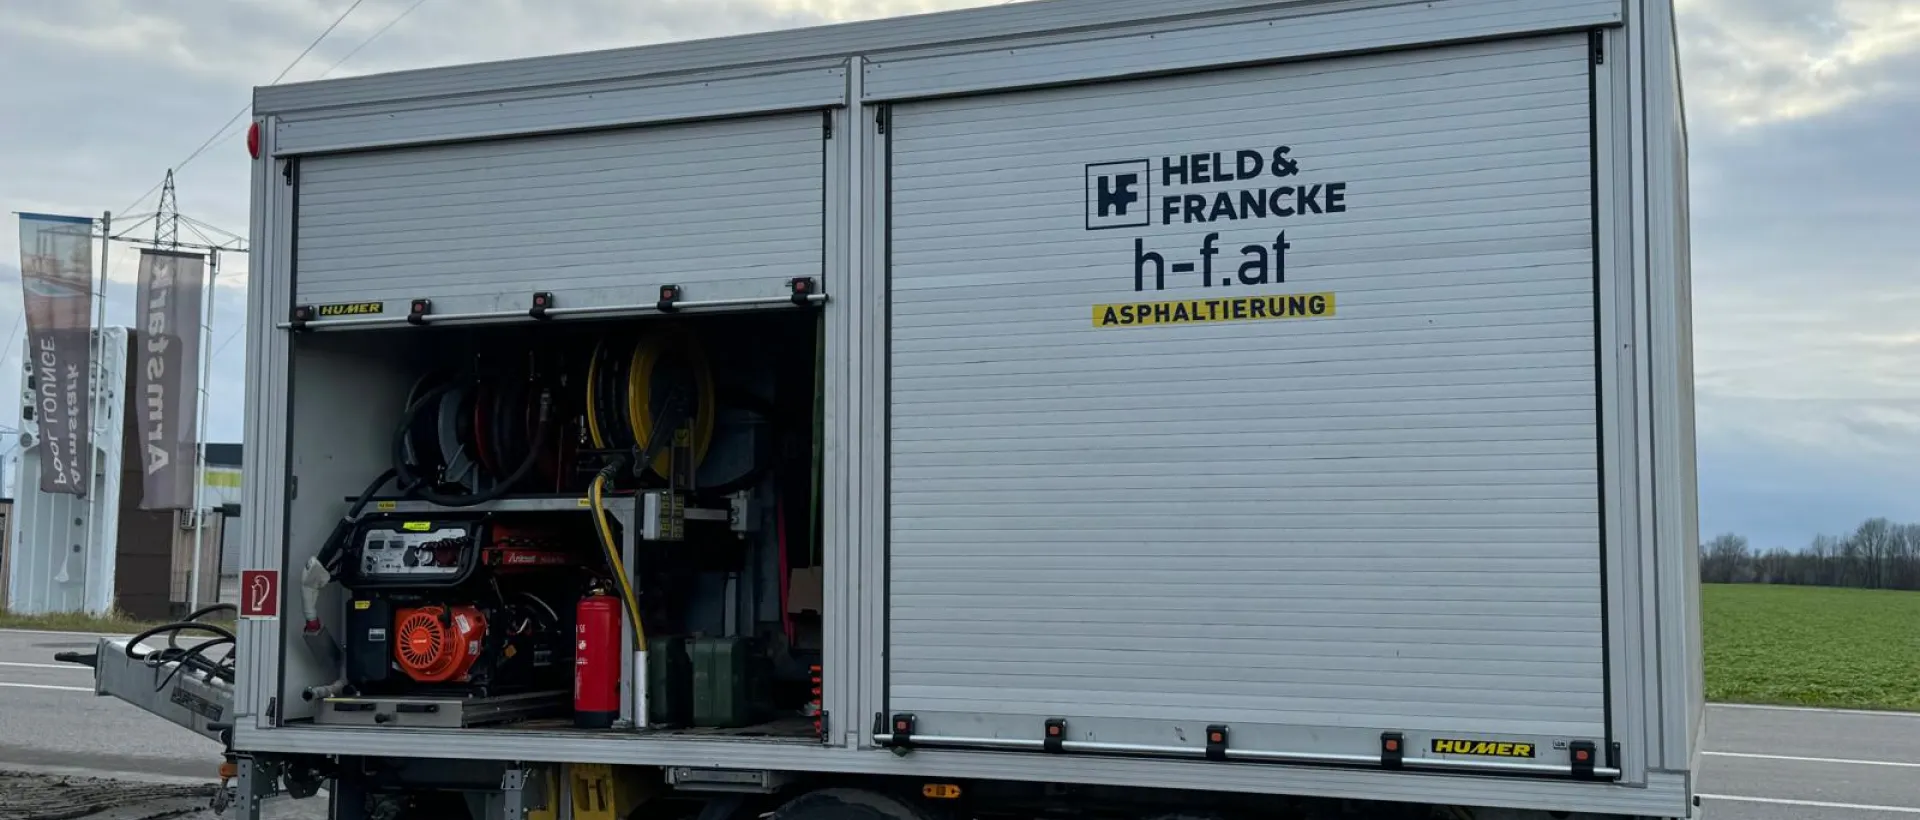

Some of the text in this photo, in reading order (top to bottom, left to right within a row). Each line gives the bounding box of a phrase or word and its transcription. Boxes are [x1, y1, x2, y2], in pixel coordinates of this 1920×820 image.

[1162, 145, 1300, 186] HELD &
[1097, 173, 1138, 217] HF
[1162, 182, 1347, 225] FRANCKE
[1134, 229, 1291, 292] h-f.at
[321, 303, 380, 315] HUMER
[1101, 295, 1327, 326] ASPHALTIERUNG
[1435, 739, 1531, 757] HUMER
